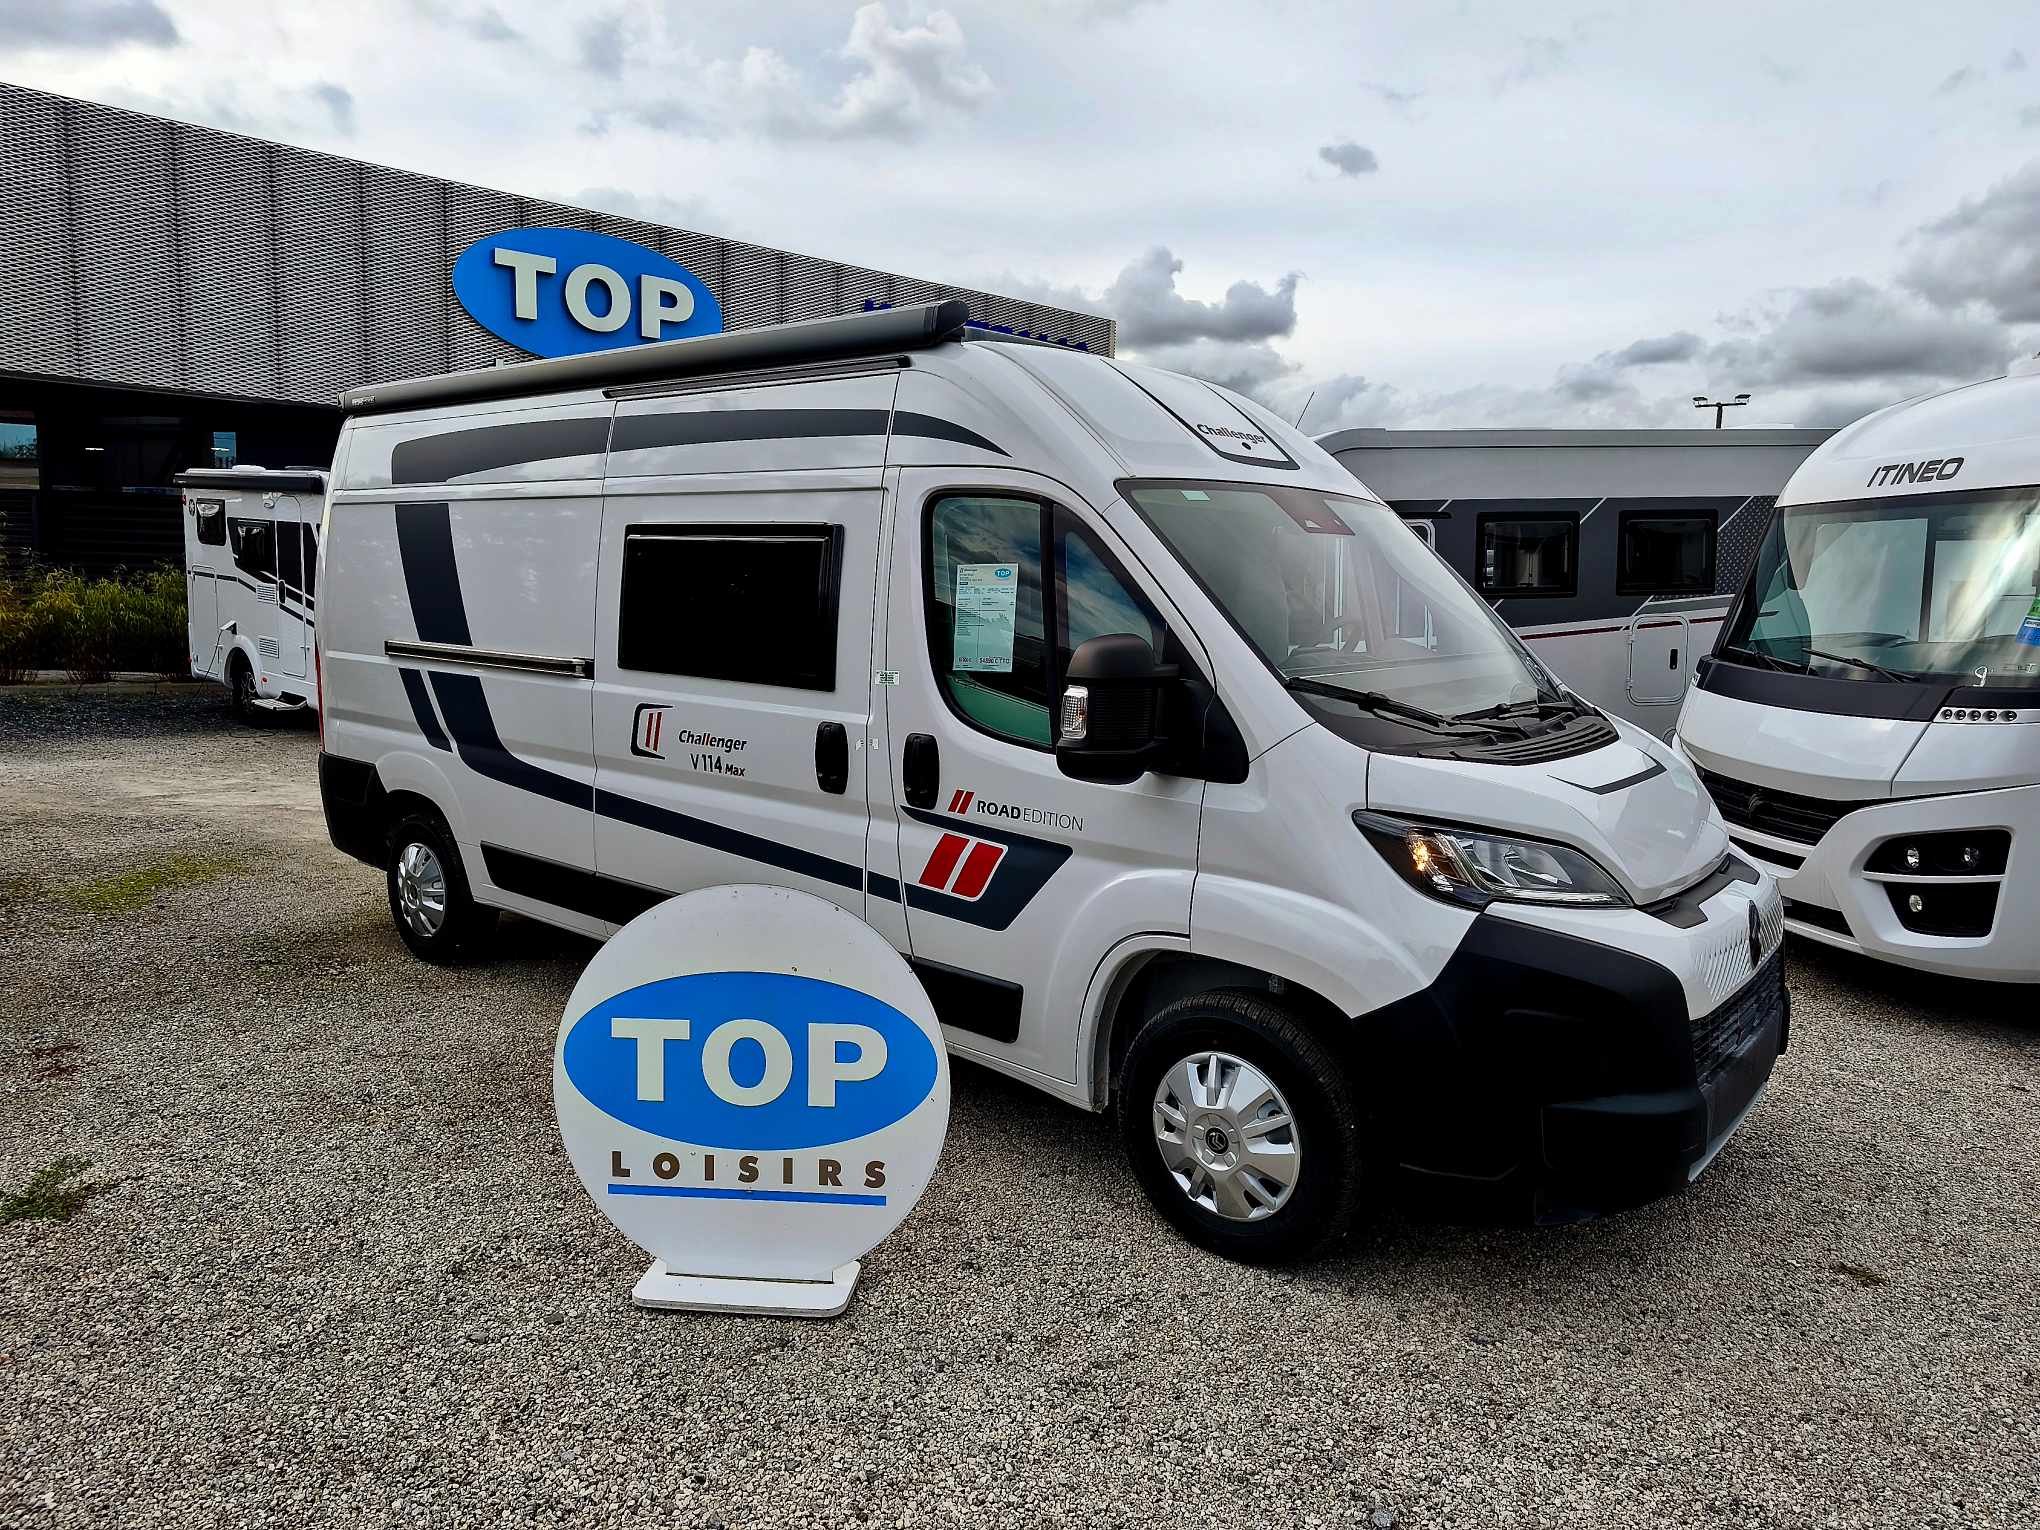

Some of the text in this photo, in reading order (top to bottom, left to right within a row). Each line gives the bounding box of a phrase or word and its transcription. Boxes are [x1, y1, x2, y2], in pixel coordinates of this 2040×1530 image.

[494, 247, 695, 339] TOP
[1196, 423, 1266, 445] Challenger
[1866, 457, 1965, 488] ITINEO
[678, 729, 748, 753] Challenger
[690, 753, 746, 777] V 114 Max
[611, 1017, 888, 1107] TOP
[611, 1150, 886, 1189] LOISIRS
